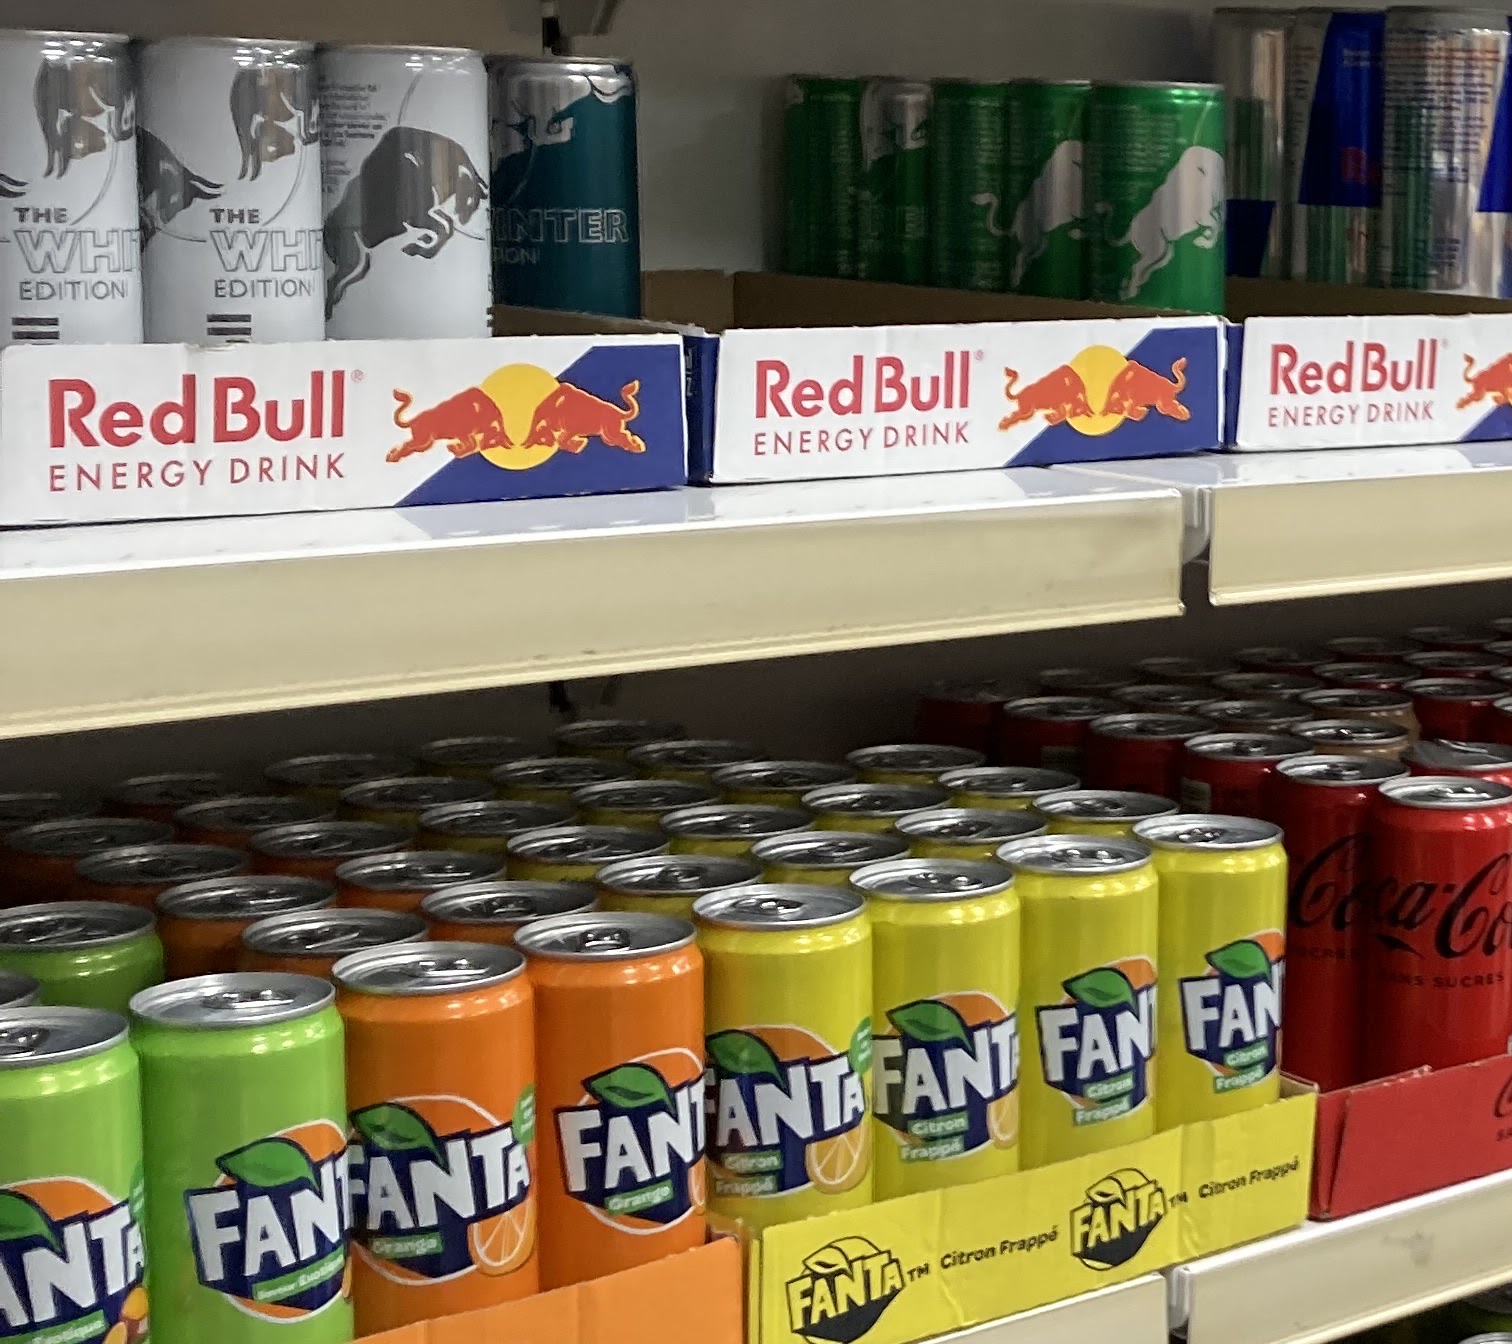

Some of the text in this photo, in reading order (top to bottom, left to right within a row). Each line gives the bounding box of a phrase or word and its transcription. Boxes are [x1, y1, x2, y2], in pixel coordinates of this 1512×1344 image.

[14, 208, 68, 224] THE
[209, 208, 260, 224] THE
[13, 228, 140, 274] WHI
[209, 229, 323, 273] WHI
[19, 280, 128, 301] EDITION
[214, 278, 316, 299] EDITION
[754, 350, 970, 419] Red Bull
[1269, 338, 1438, 396] Red Bull
[48, 369, 346, 449] Red Bull
[1268, 400, 1434, 428] ENERGY DRINK
[754, 421, 970, 456] ENERGY DRINK
[49, 452, 346, 493] ENERGY DRINK
[1181, 956, 1285, 1050] FAN
[872, 1017, 1020, 1116] FANT
[556, 1076, 706, 1194] FANT
[911, 1115, 968, 1135] Citron
[901, 1139, 963, 1161] Frappé
[609, 1185, 673, 1211] Orange
[1068, 1180, 1168, 1254] FANTA
[1198, 1176, 1248, 1199] Citron
[1249, 1155, 1301, 1188] Frappé
[0, 1205, 146, 1329] ANTA
[372, 1236, 438, 1256] Orange
[784, 1251, 907, 1331] FANTA
[940, 1245, 997, 1271] Citron
[998, 1224, 1060, 1258] Frappé
